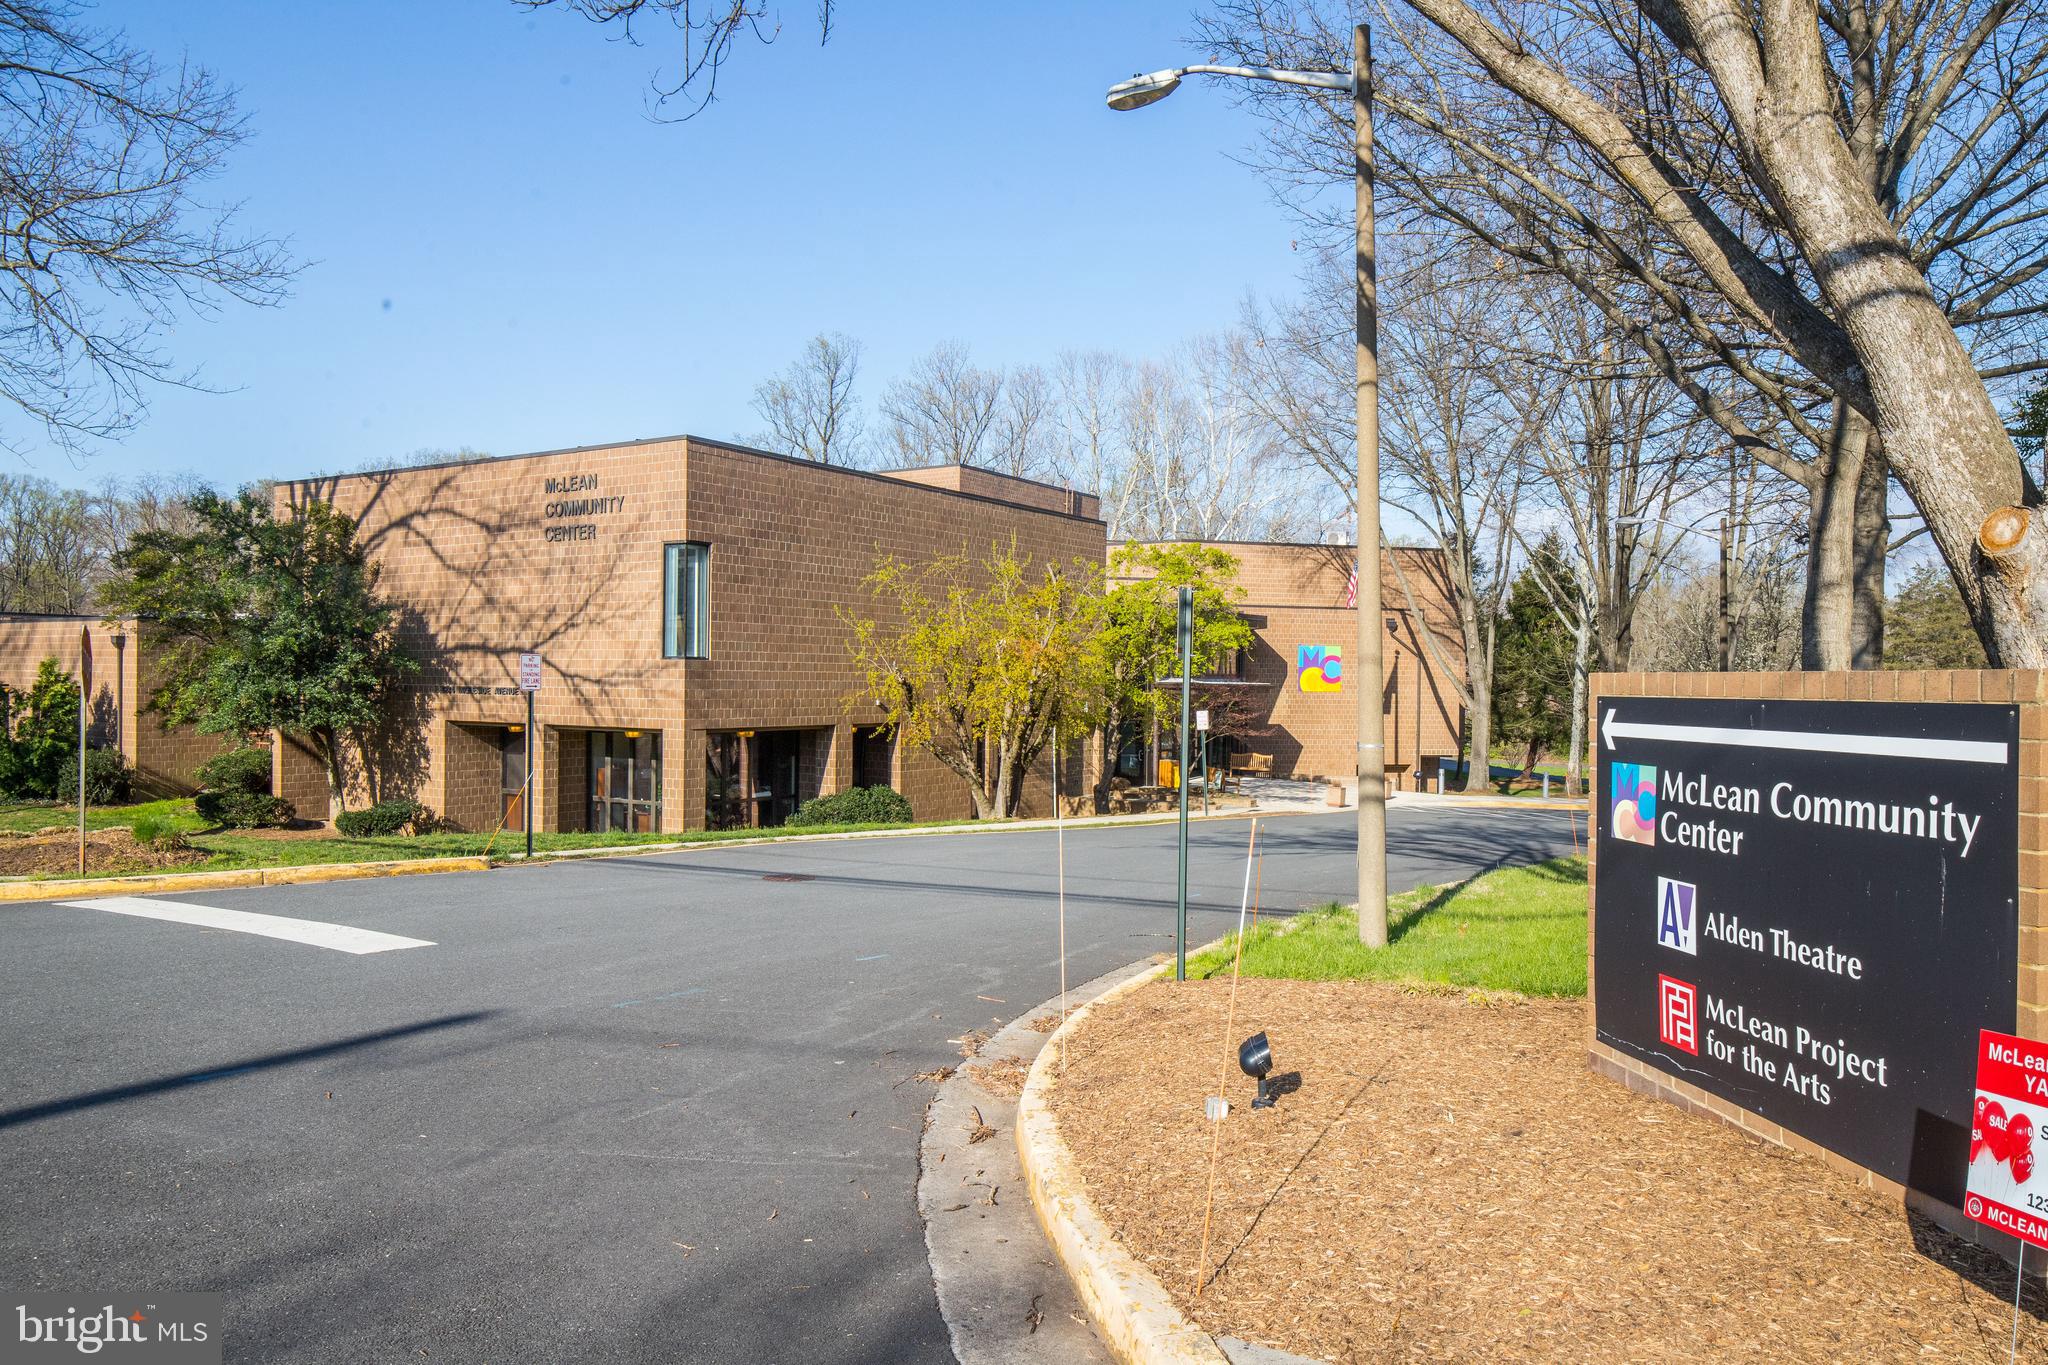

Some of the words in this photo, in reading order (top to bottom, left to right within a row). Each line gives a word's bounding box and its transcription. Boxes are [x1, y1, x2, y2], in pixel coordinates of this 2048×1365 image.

[545, 474, 598, 493] McLEAN
[545, 496, 625, 518] COMMUNITY
[544, 524, 597, 542] CENTER
[495, 686, 520, 695] AVENUE
[1661, 769, 1759, 814] McLean
[1770, 782, 1981, 858] Community
[1660, 811, 1743, 855] Center
[1704, 912, 1764, 952] Alden
[1769, 928, 1862, 980] Theatre
[1705, 994, 1788, 1049] McLean
[1796, 1026, 1888, 1087] Project
[1705, 1029, 1736, 1064] for
[1742, 1045, 1776, 1082] the
[1782, 1062, 1831, 1106] Arts
[1988, 1042, 2048, 1073] McLea
[2024, 1074, 2048, 1098] YA
[1989, 1114, 2008, 1131] SALE
[1987, 1206, 2048, 1241] MCLEAN
